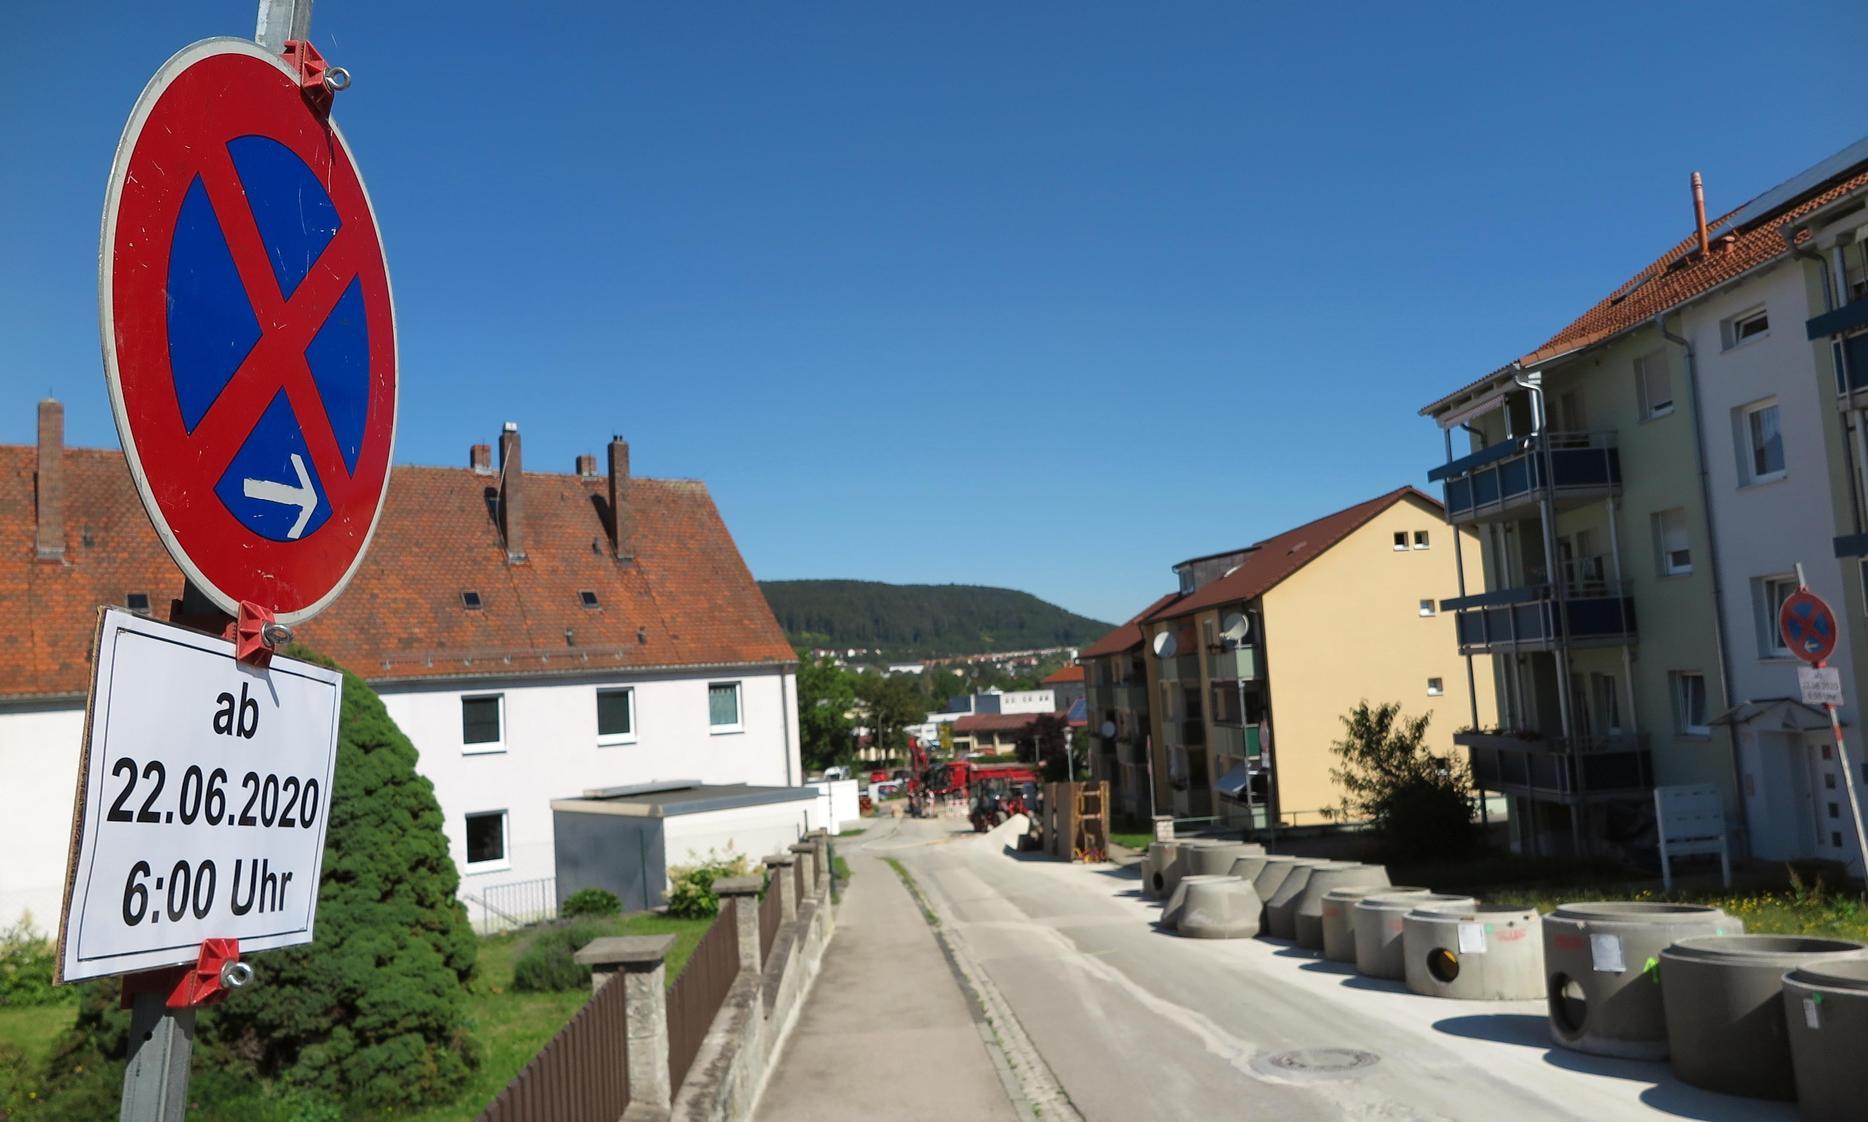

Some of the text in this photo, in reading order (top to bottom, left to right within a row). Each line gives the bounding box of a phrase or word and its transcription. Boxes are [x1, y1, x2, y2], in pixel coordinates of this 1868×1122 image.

[212, 681, 260, 740] ab
[106, 756, 320, 829] 22.06.2020
[121, 858, 293, 927] 6:00 Uhr
